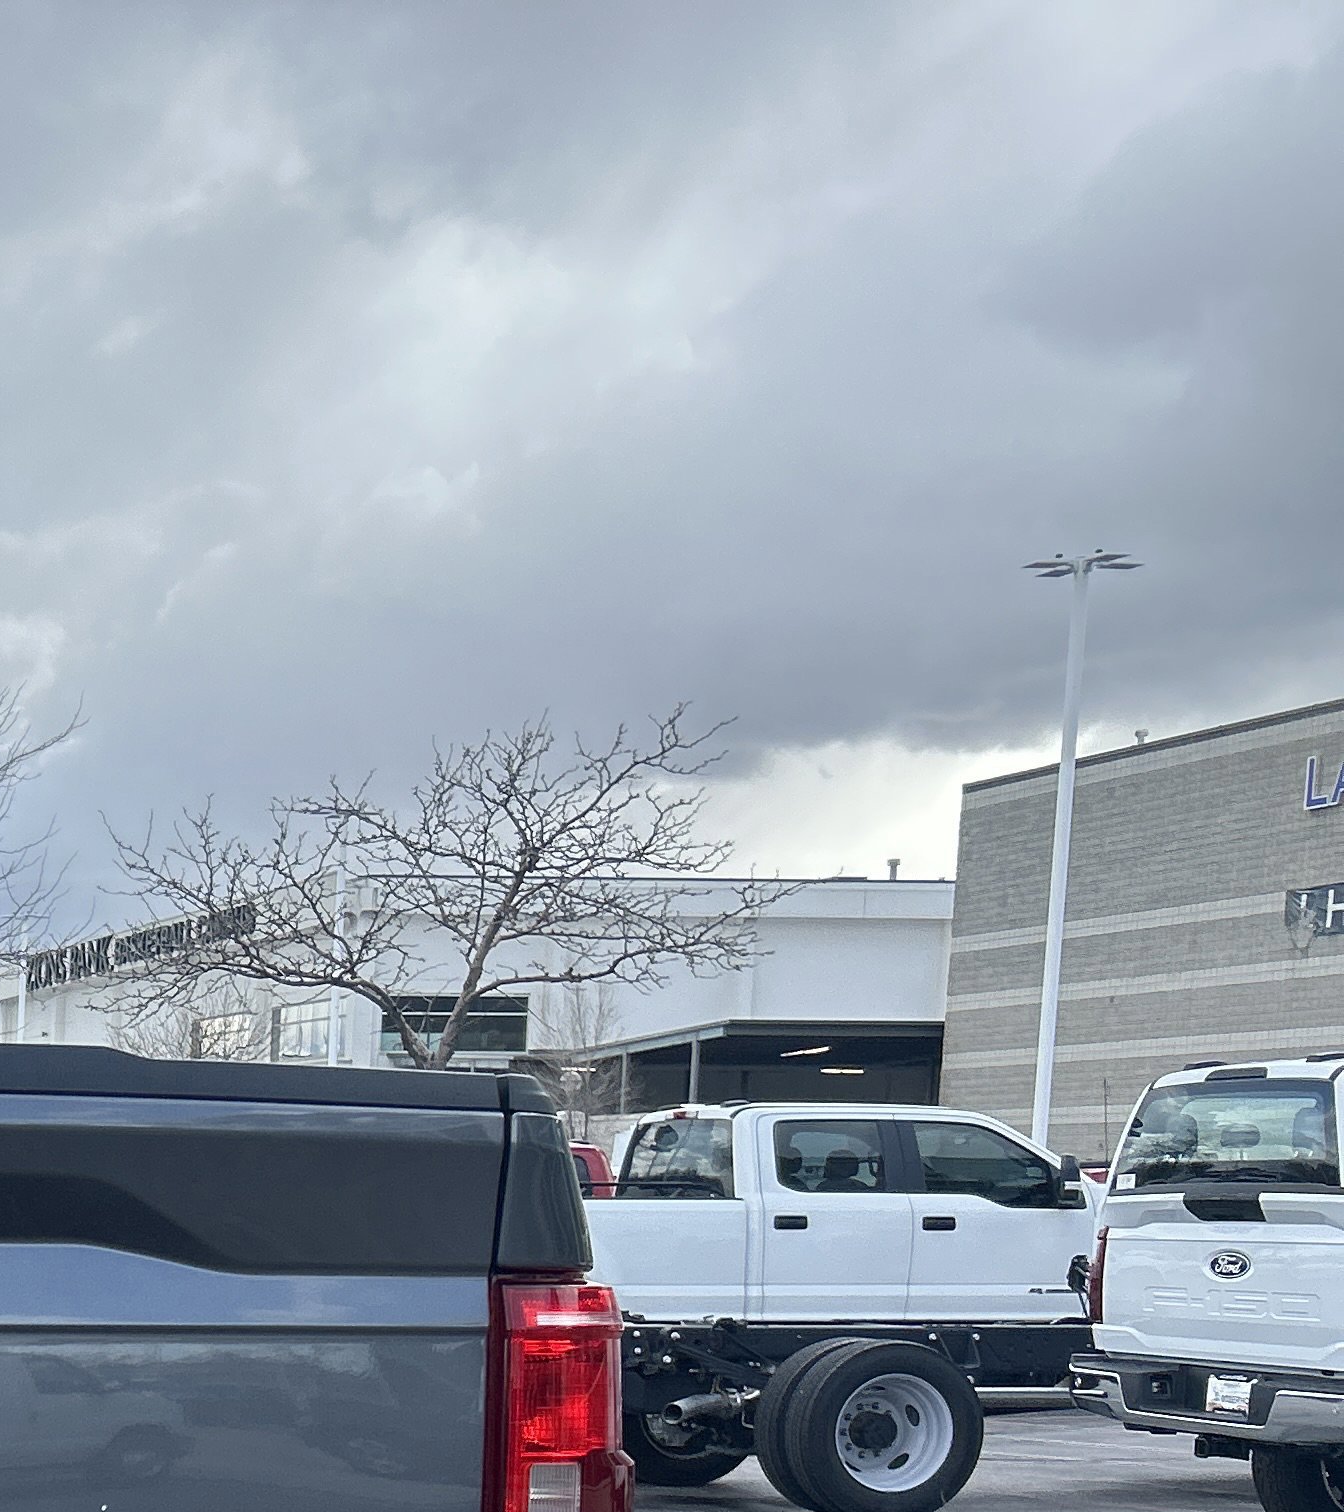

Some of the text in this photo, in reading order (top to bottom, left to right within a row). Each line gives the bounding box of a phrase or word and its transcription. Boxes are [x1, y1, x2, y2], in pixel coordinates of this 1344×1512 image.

[69, 935, 113, 980] BANK
[1214, 1255, 1243, 1274] Ford
[1142, 1285, 1321, 1322] F-150
